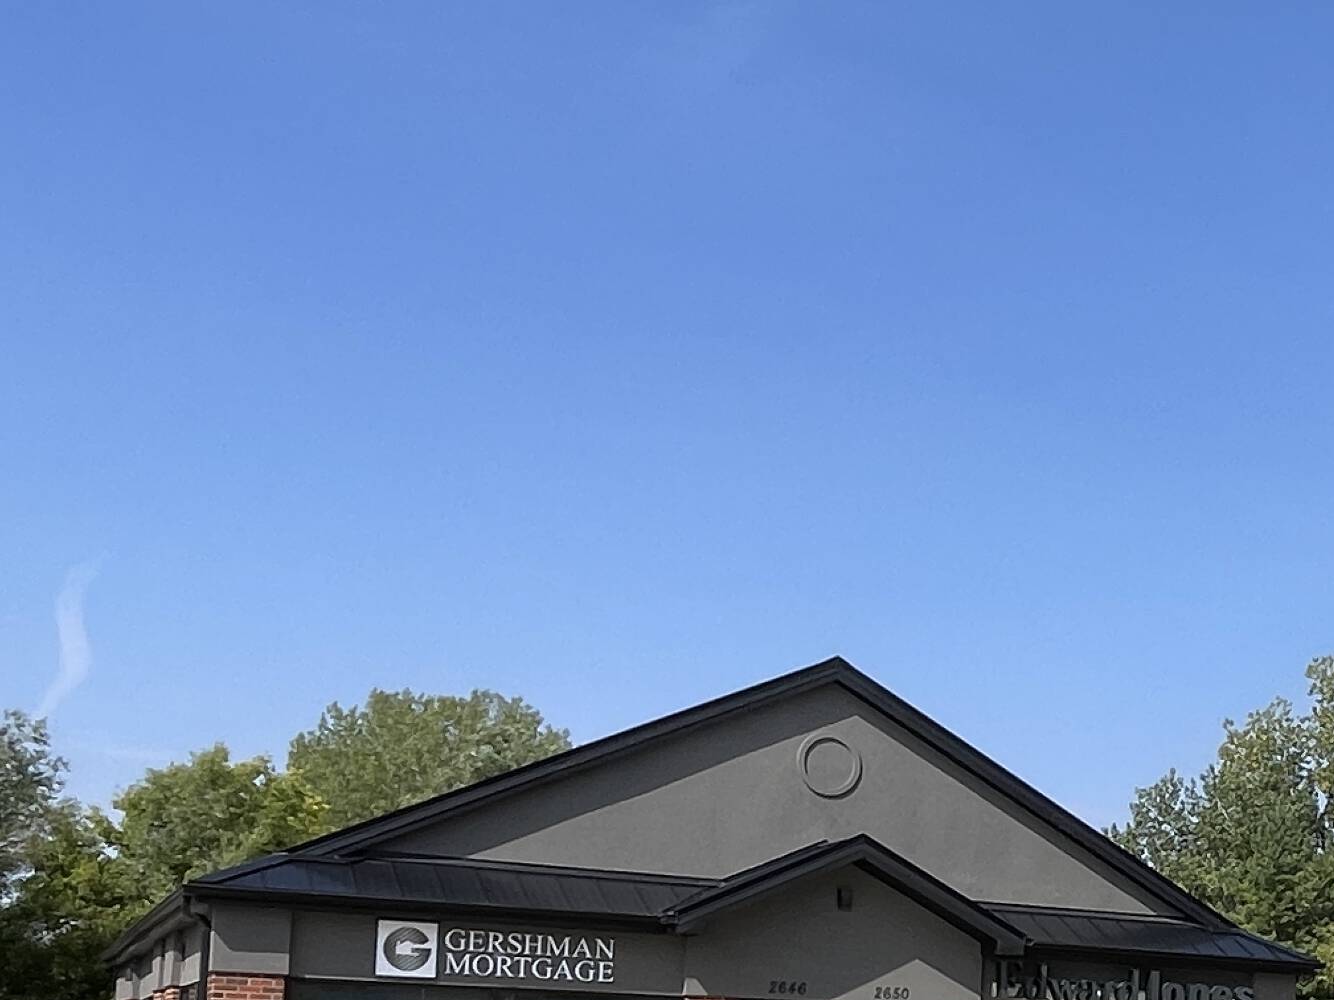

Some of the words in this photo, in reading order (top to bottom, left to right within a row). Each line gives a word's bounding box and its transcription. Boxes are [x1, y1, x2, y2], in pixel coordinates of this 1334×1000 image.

[444, 928, 615, 959] GERSHMAN
[444, 953, 615, 983] MORTGAGE
[874, 986, 910, 1000] 2650
